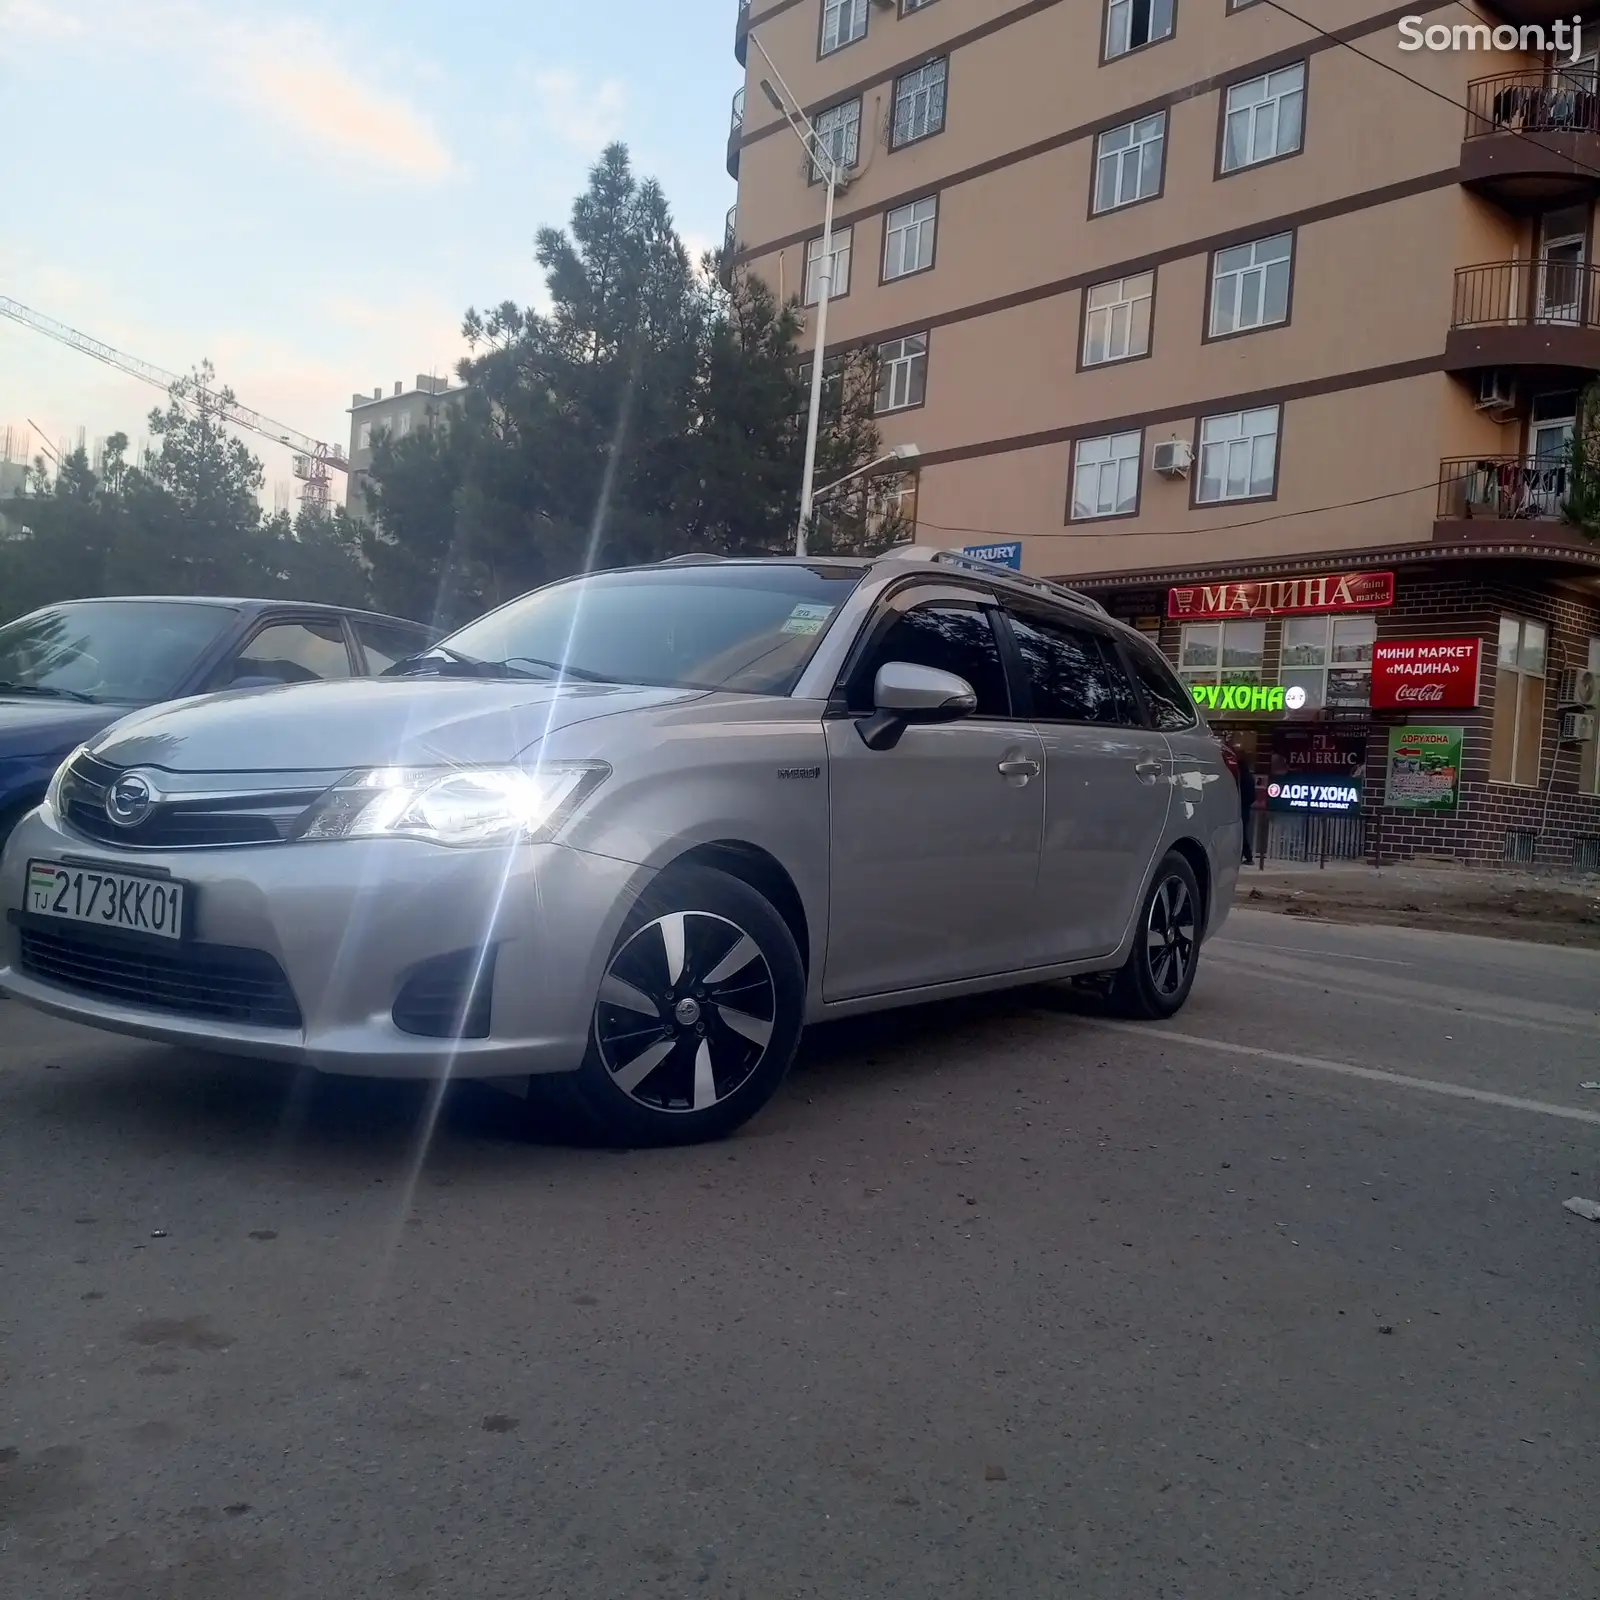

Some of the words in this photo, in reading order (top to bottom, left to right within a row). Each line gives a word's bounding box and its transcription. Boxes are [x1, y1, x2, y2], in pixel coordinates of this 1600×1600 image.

[1362, 579, 1384, 589] mini
[1200, 576, 1355, 617] МАДИНА
[1356, 591, 1390, 602] market
[1377, 648, 1414, 659] МИНИ
[1418, 646, 1474, 658] МАРКЕТ
[1386, 663, 1460, 675] «МАДИНА»
[1189, 685, 1285, 712] РУХОНА
[1395, 683, 1447, 701] Coca-Cola
[33, 892, 48, 909] TJ
[52, 870, 178, 934] 2173KK01
